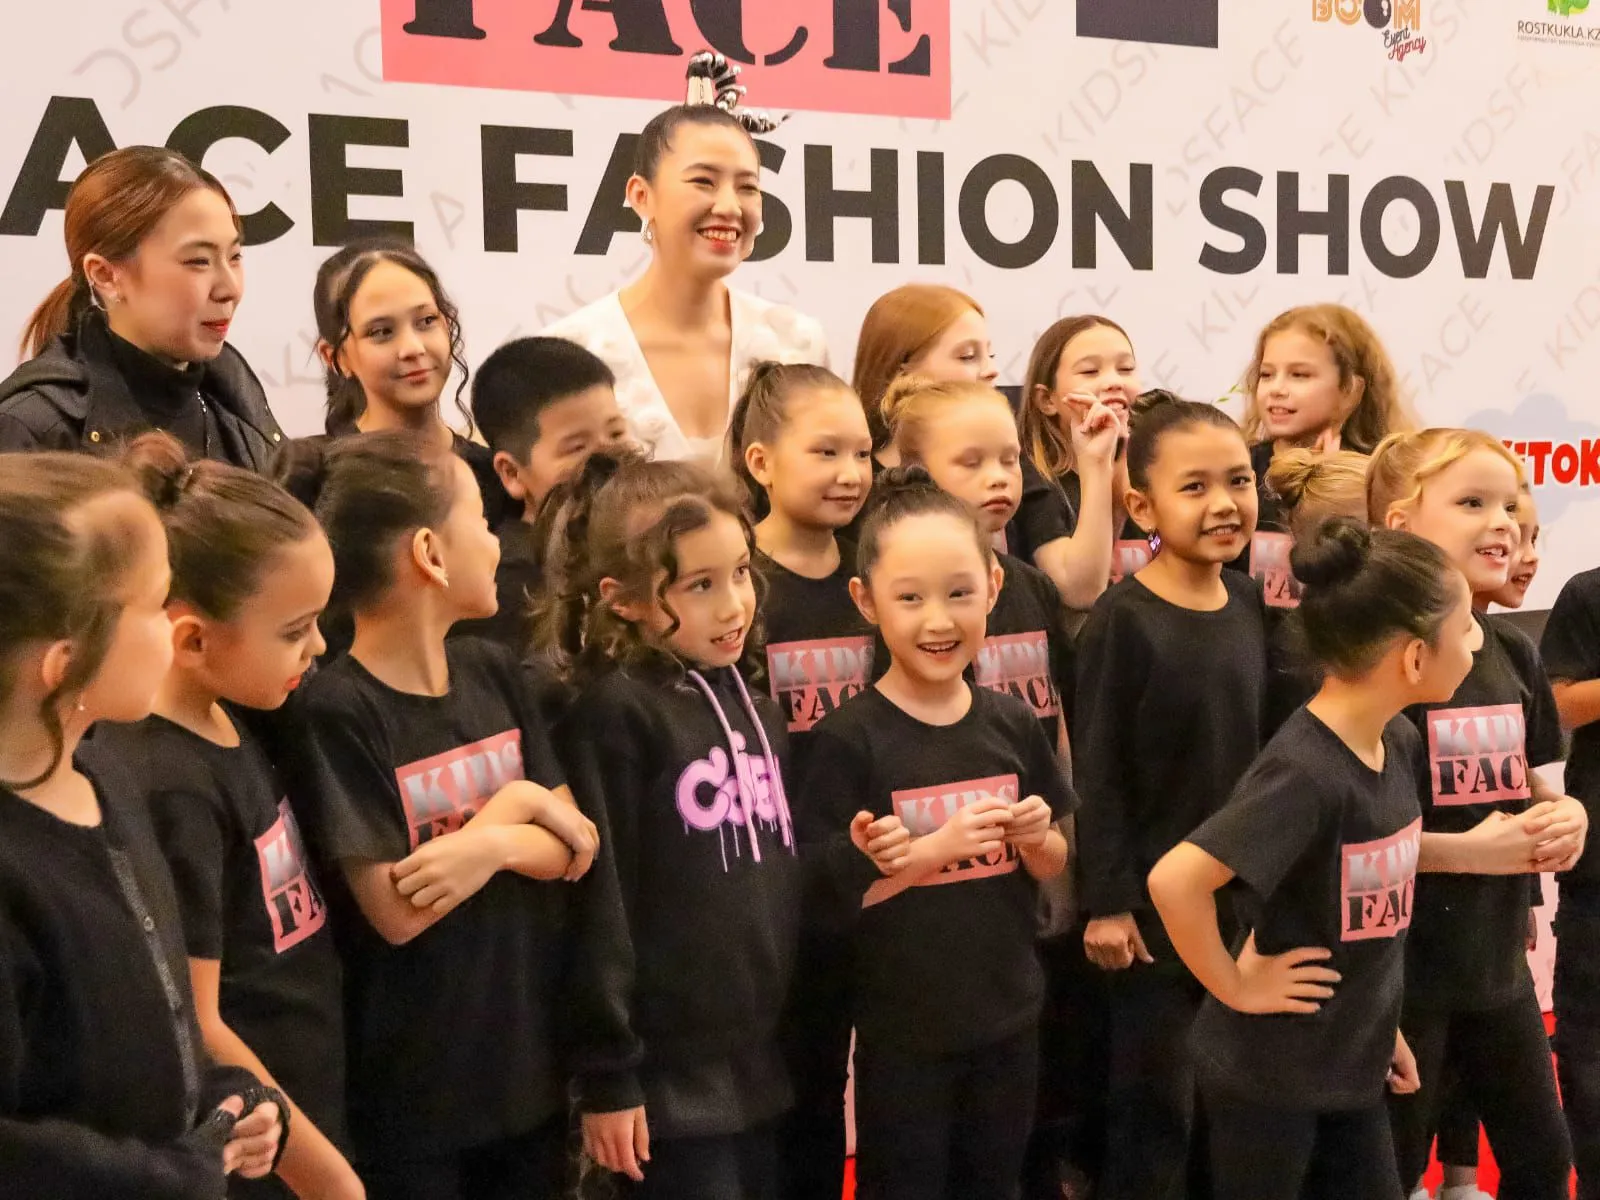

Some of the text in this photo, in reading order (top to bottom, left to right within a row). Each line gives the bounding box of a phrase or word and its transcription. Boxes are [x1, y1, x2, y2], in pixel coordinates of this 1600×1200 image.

[1388, 36, 1426, 62] Agency
[1198, 165, 1554, 280] SHOW
[1432, 713, 1526, 757] KID
